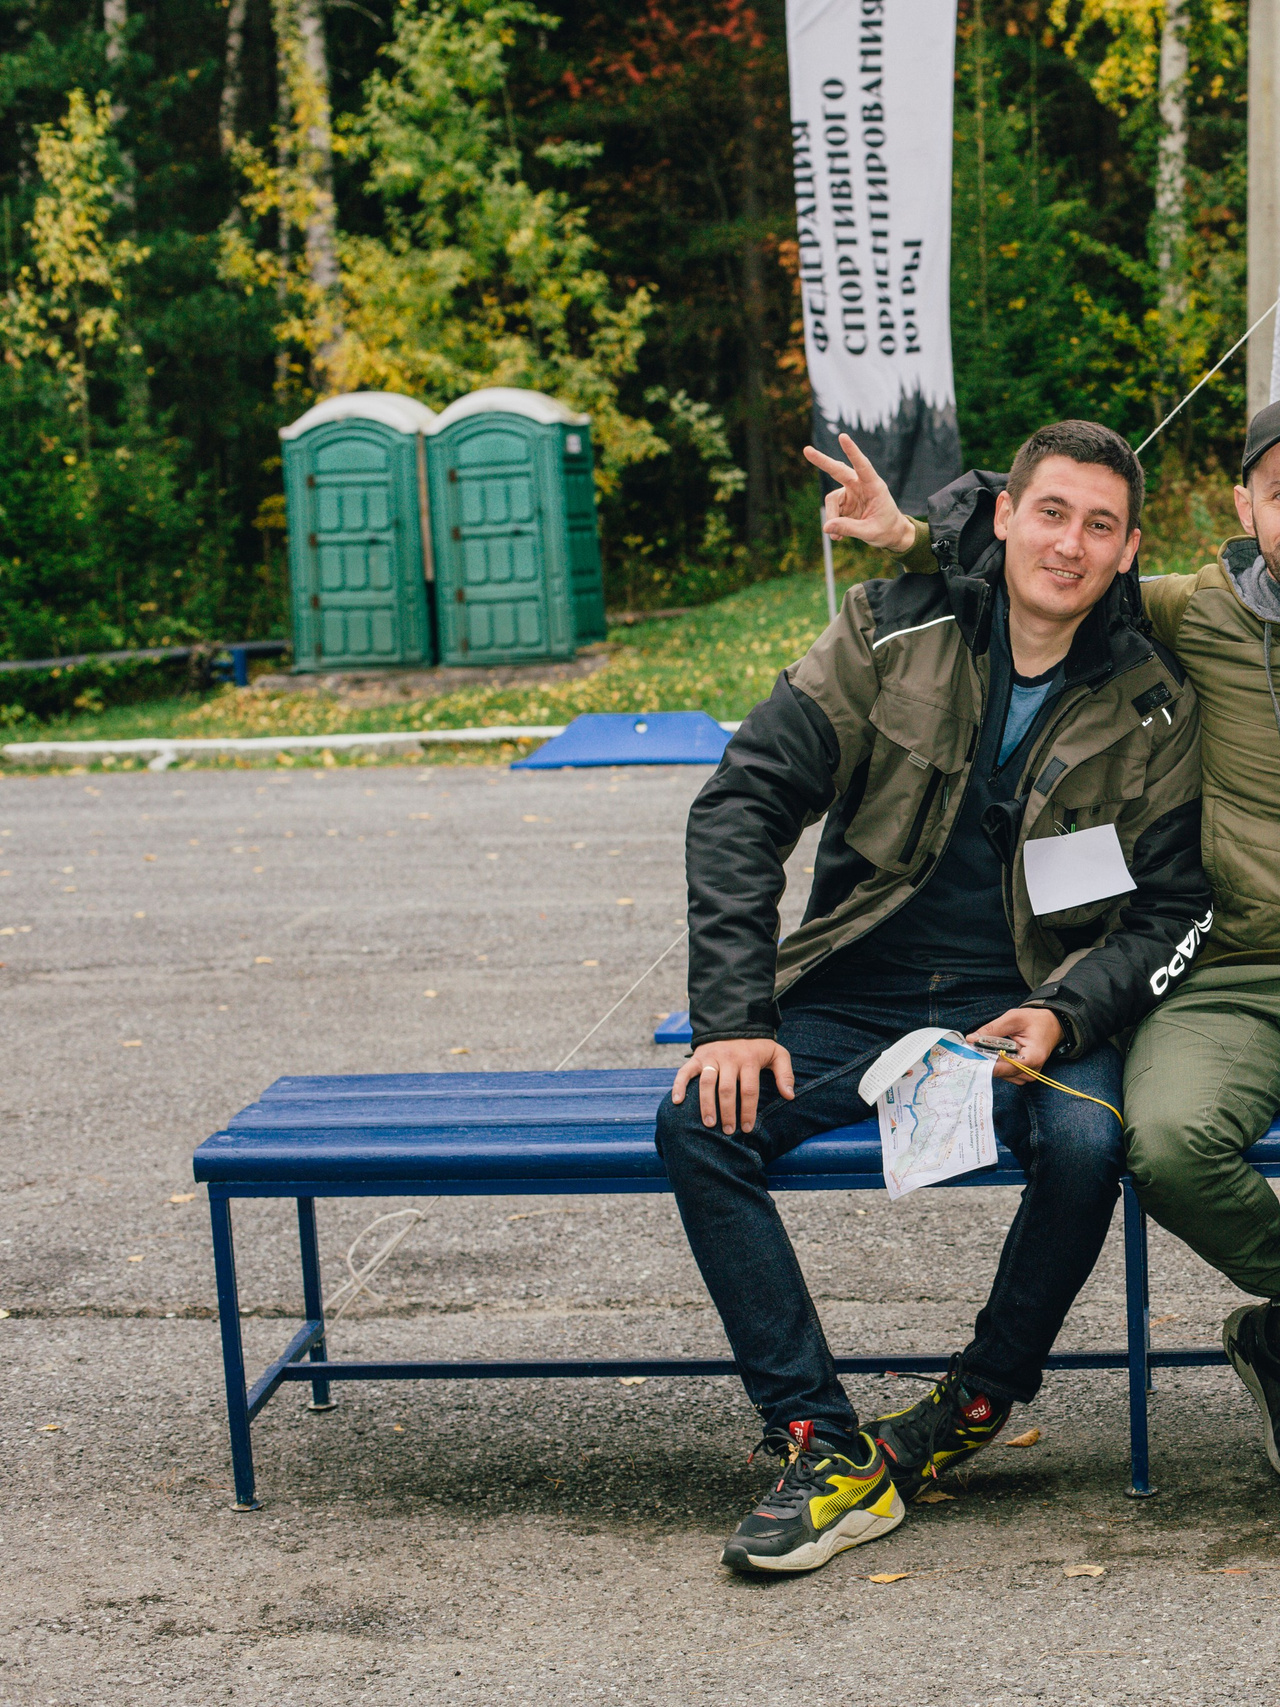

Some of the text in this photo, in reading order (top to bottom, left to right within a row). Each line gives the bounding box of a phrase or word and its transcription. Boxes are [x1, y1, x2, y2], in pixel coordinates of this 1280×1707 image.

[791, 120, 829, 353] ФЕДЕРАЦИЯ
[821, 77, 868, 356] СПОРТИВНОГО
[858, 0, 897, 356] ОРИЕНТИРОВАНИЯ
[901, 238, 923, 354] ЮГРЫ
